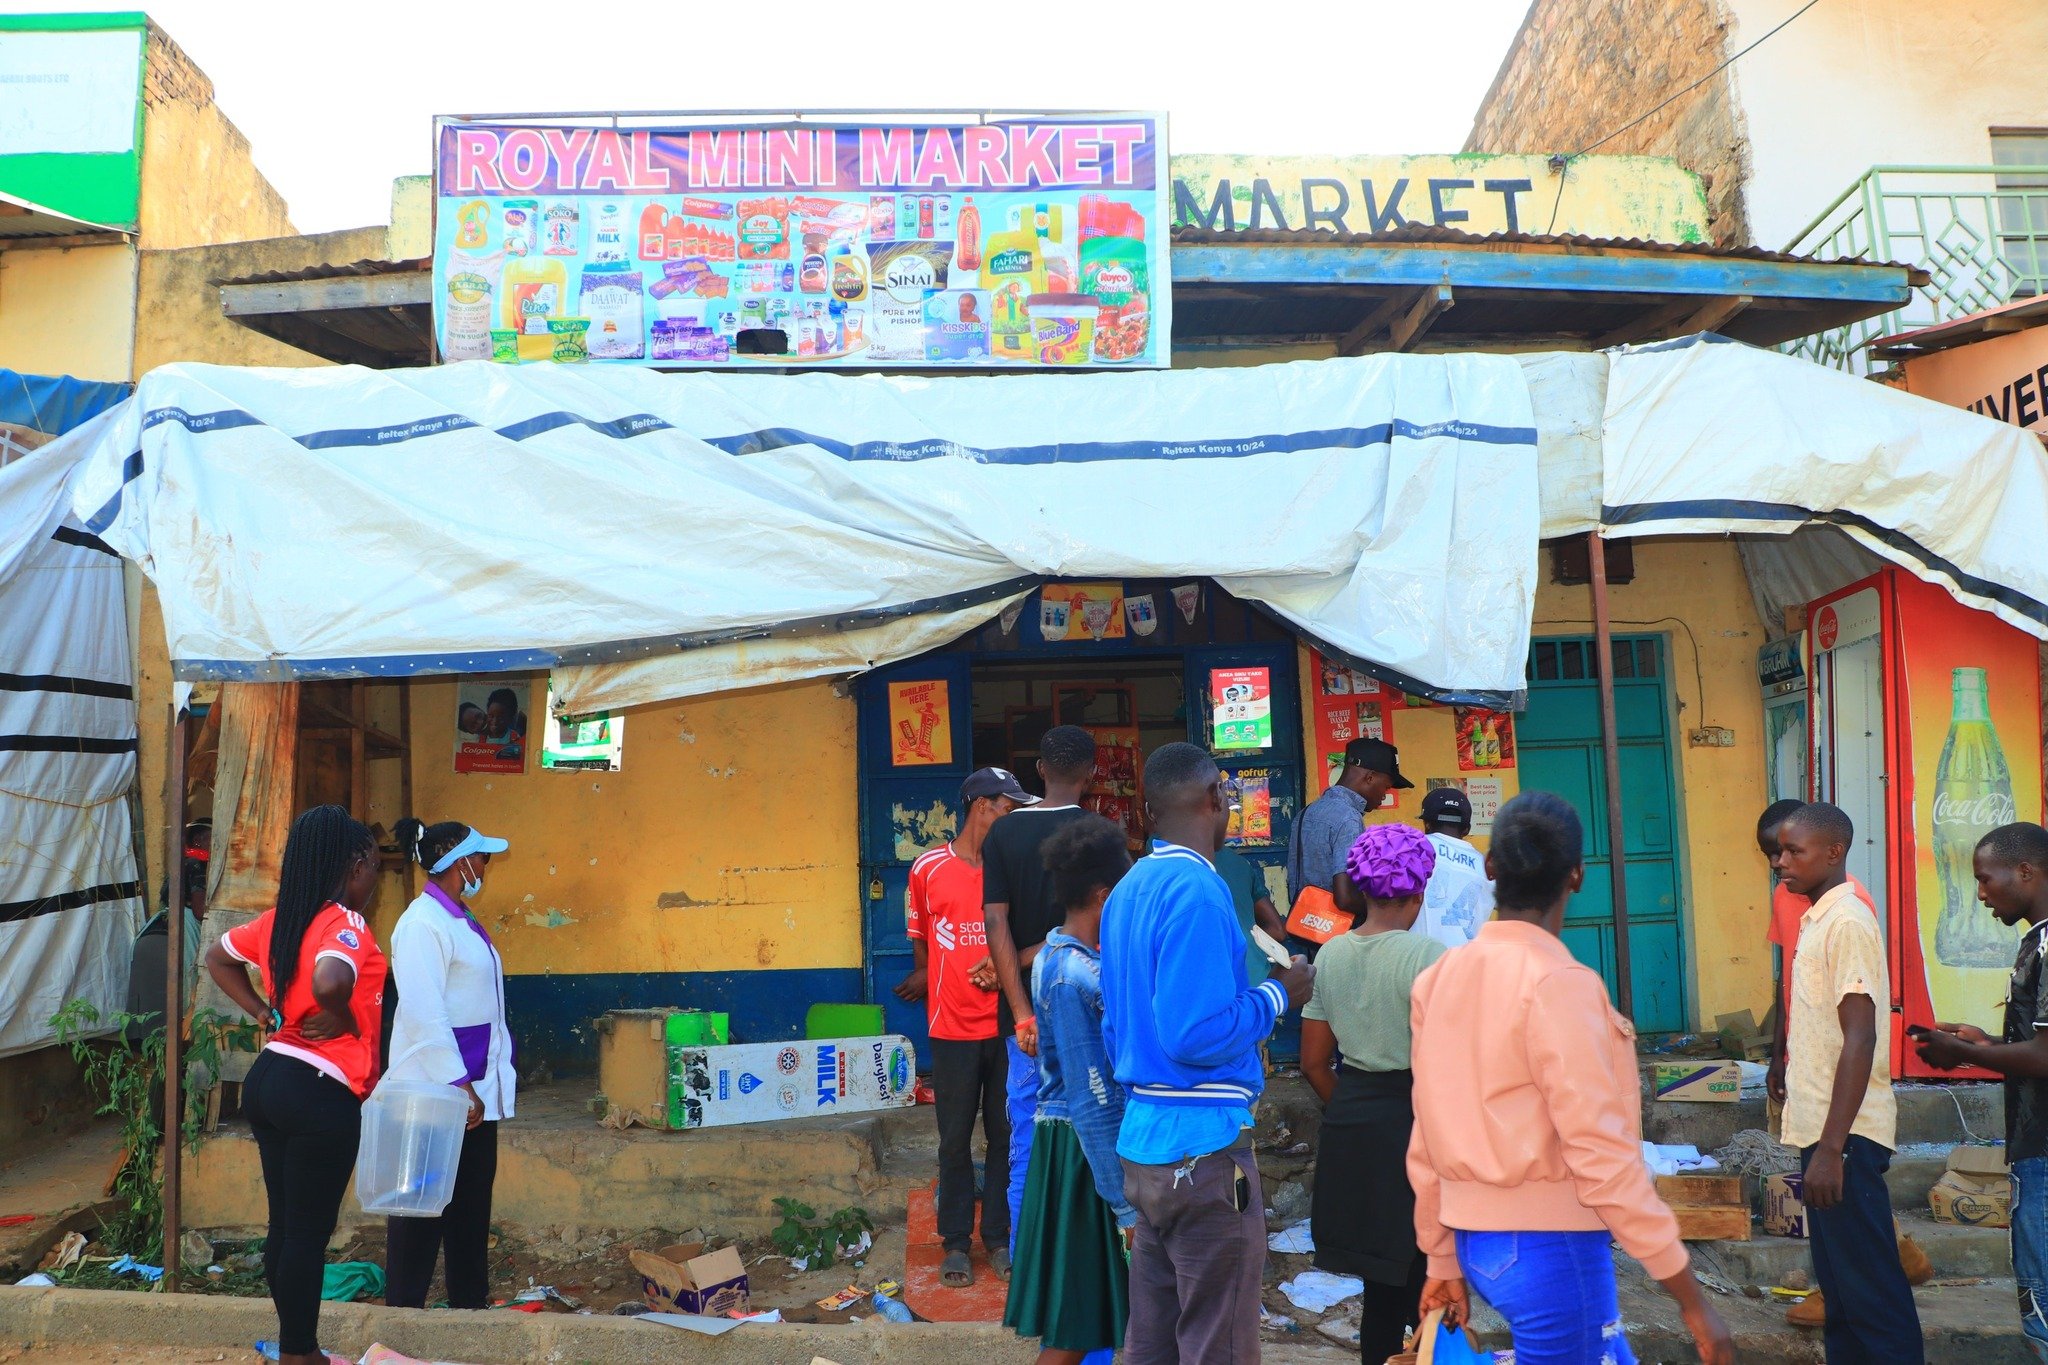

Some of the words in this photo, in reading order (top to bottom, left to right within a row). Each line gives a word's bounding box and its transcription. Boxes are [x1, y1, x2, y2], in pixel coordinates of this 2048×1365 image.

[456, 128, 670, 191] ROYAL
[688, 127, 838, 188] MINI
[859, 123, 1146, 187] MARKET
[684, 198, 715, 209] Colgate
[1172, 177, 1533, 234] MARKET
[547, 209, 572, 218] SOKO
[596, 233, 621, 243] MILK
[993, 254, 1029, 268] FAHARI
[590, 293, 629, 305] DAAWAT
[155, 410, 188, 422] Kenya
[189, 416, 216, 428] 10/24
[631, 418, 663, 430] Reltex
[377, 428, 409, 440] Reltex
[411, 421, 443, 432] Kenya
[1162, 446, 1196, 456] Reltex
[1198, 444, 1233, 454] Kenya
[1235, 440, 1266, 452] 10/24
[899, 682, 936, 698] AVAILABLE
[909, 692, 929, 705] HERE
[463, 746, 495, 755] Colgate
[1237, 768, 1269, 779] gofrut
[1932, 791, 2016, 826] Coca-Cola
[1438, 843, 1476, 870] CLARK
[1300, 912, 1334, 932] JESUS
[817, 1044, 836, 1107] MILK
[872, 1042, 892, 1102] DairyBest
